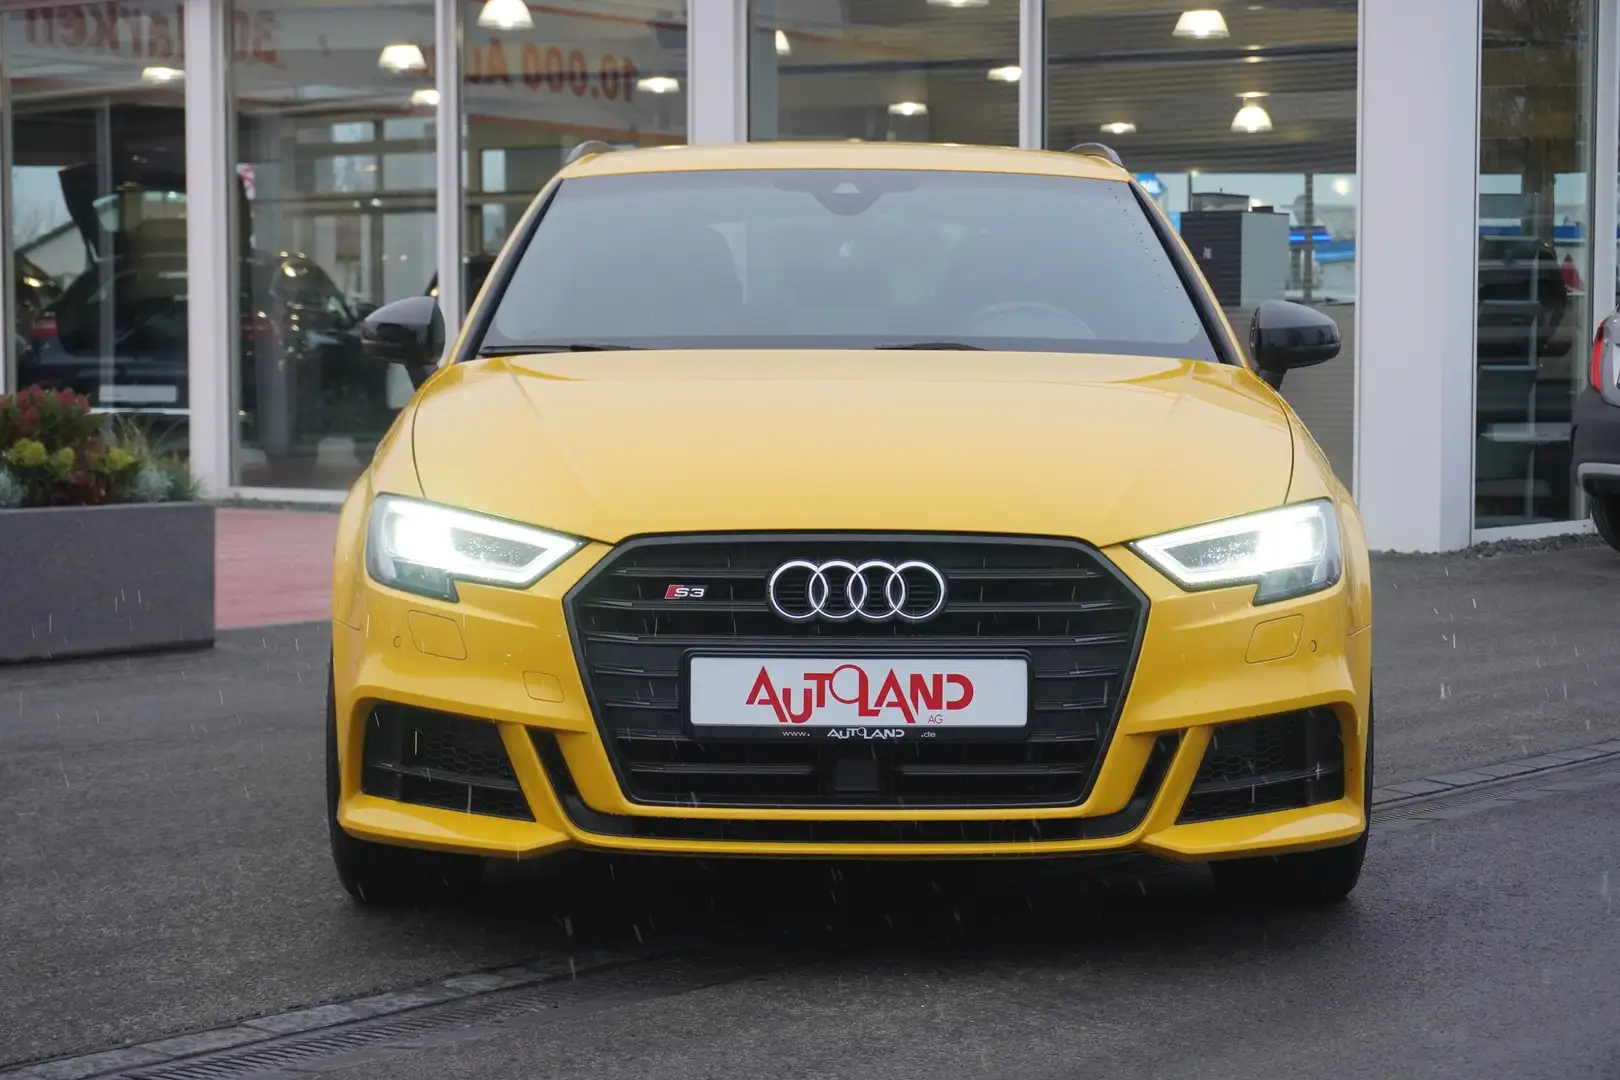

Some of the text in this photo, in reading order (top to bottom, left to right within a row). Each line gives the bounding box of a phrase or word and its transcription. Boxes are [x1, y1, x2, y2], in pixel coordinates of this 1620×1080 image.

[674, 587, 705, 598] S3
[927, 714, 943, 724] AG
[920, 730, 936, 738] .de
